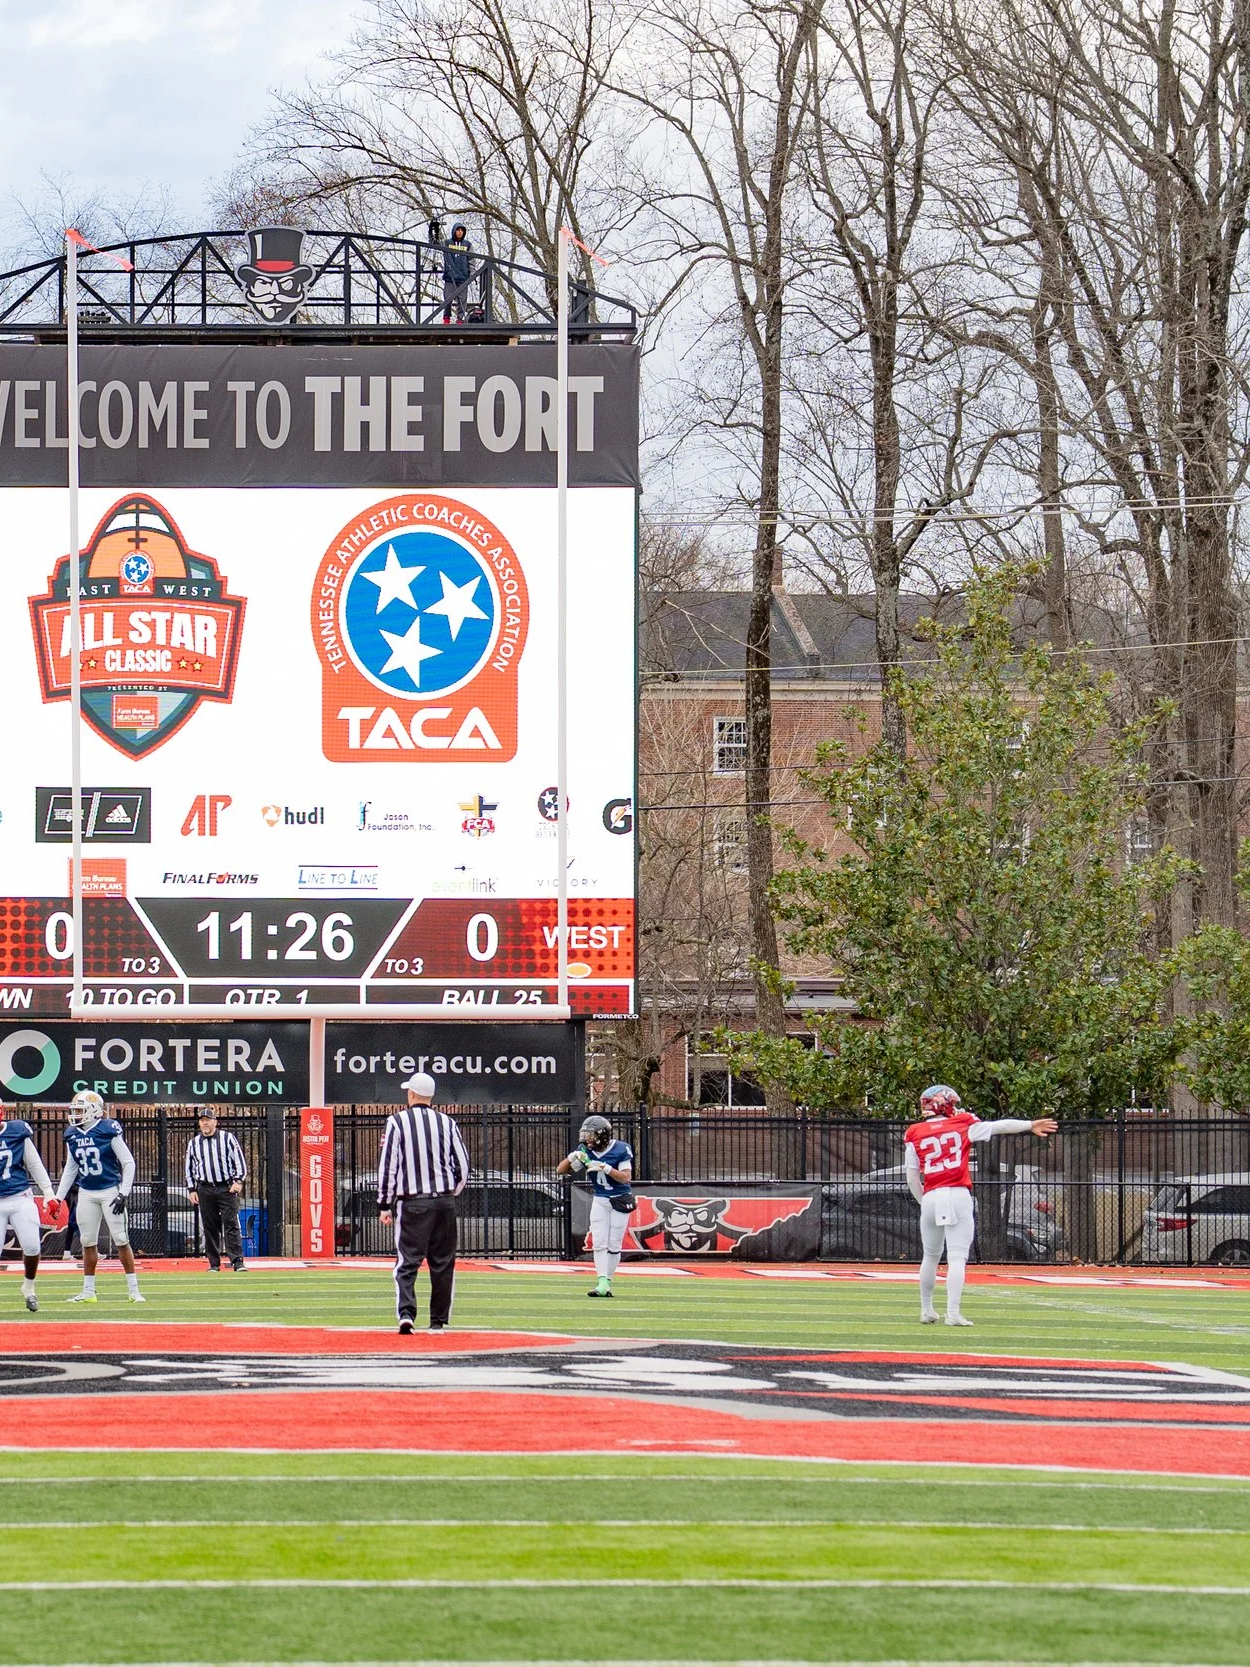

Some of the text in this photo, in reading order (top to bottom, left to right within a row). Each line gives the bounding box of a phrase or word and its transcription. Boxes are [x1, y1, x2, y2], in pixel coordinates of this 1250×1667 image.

[227, 380, 291, 449] TO
[304, 376, 424, 452] THE
[443, 375, 603, 452] FORT
[122, 584, 152, 593] TACA
[162, 584, 212, 597] WEST
[319, 503, 521, 674] TENNESSEE ATHLETIC COACHES ASSOCIATION
[60, 610, 217, 659] ALL STAR
[104, 649, 172, 673] CLASSIC
[337, 706, 502, 749] TACA
[181, 795, 233, 837] AP
[284, 806, 325, 825] hudl
[383, 813, 409, 821] Jason
[466, 819, 491, 830] FCA
[536, 878, 598, 887] VICORY
[44, 911, 75, 961] 0
[197, 911, 355, 962] 11:26
[466, 912, 499, 963] 0
[542, 925, 626, 949] WEST
[121, 956, 161, 975] TO 3
[384, 957, 424, 975] TO 3
[65, 988, 176, 1008] 10 TO GO
[225, 988, 310, 1005] QTR 1
[513, 989, 543, 1005] 25
[75, 1038, 285, 1072] FORTERA
[334, 1047, 557, 1074] forteracu.com
[73, 1080, 284, 1096] CREDIT UNION
[75, 1137, 96, 1147] TACA
[919, 1131, 962, 1175] 23
[75, 1146, 103, 1177] 33
[309, 1154, 323, 1253] GOVS
